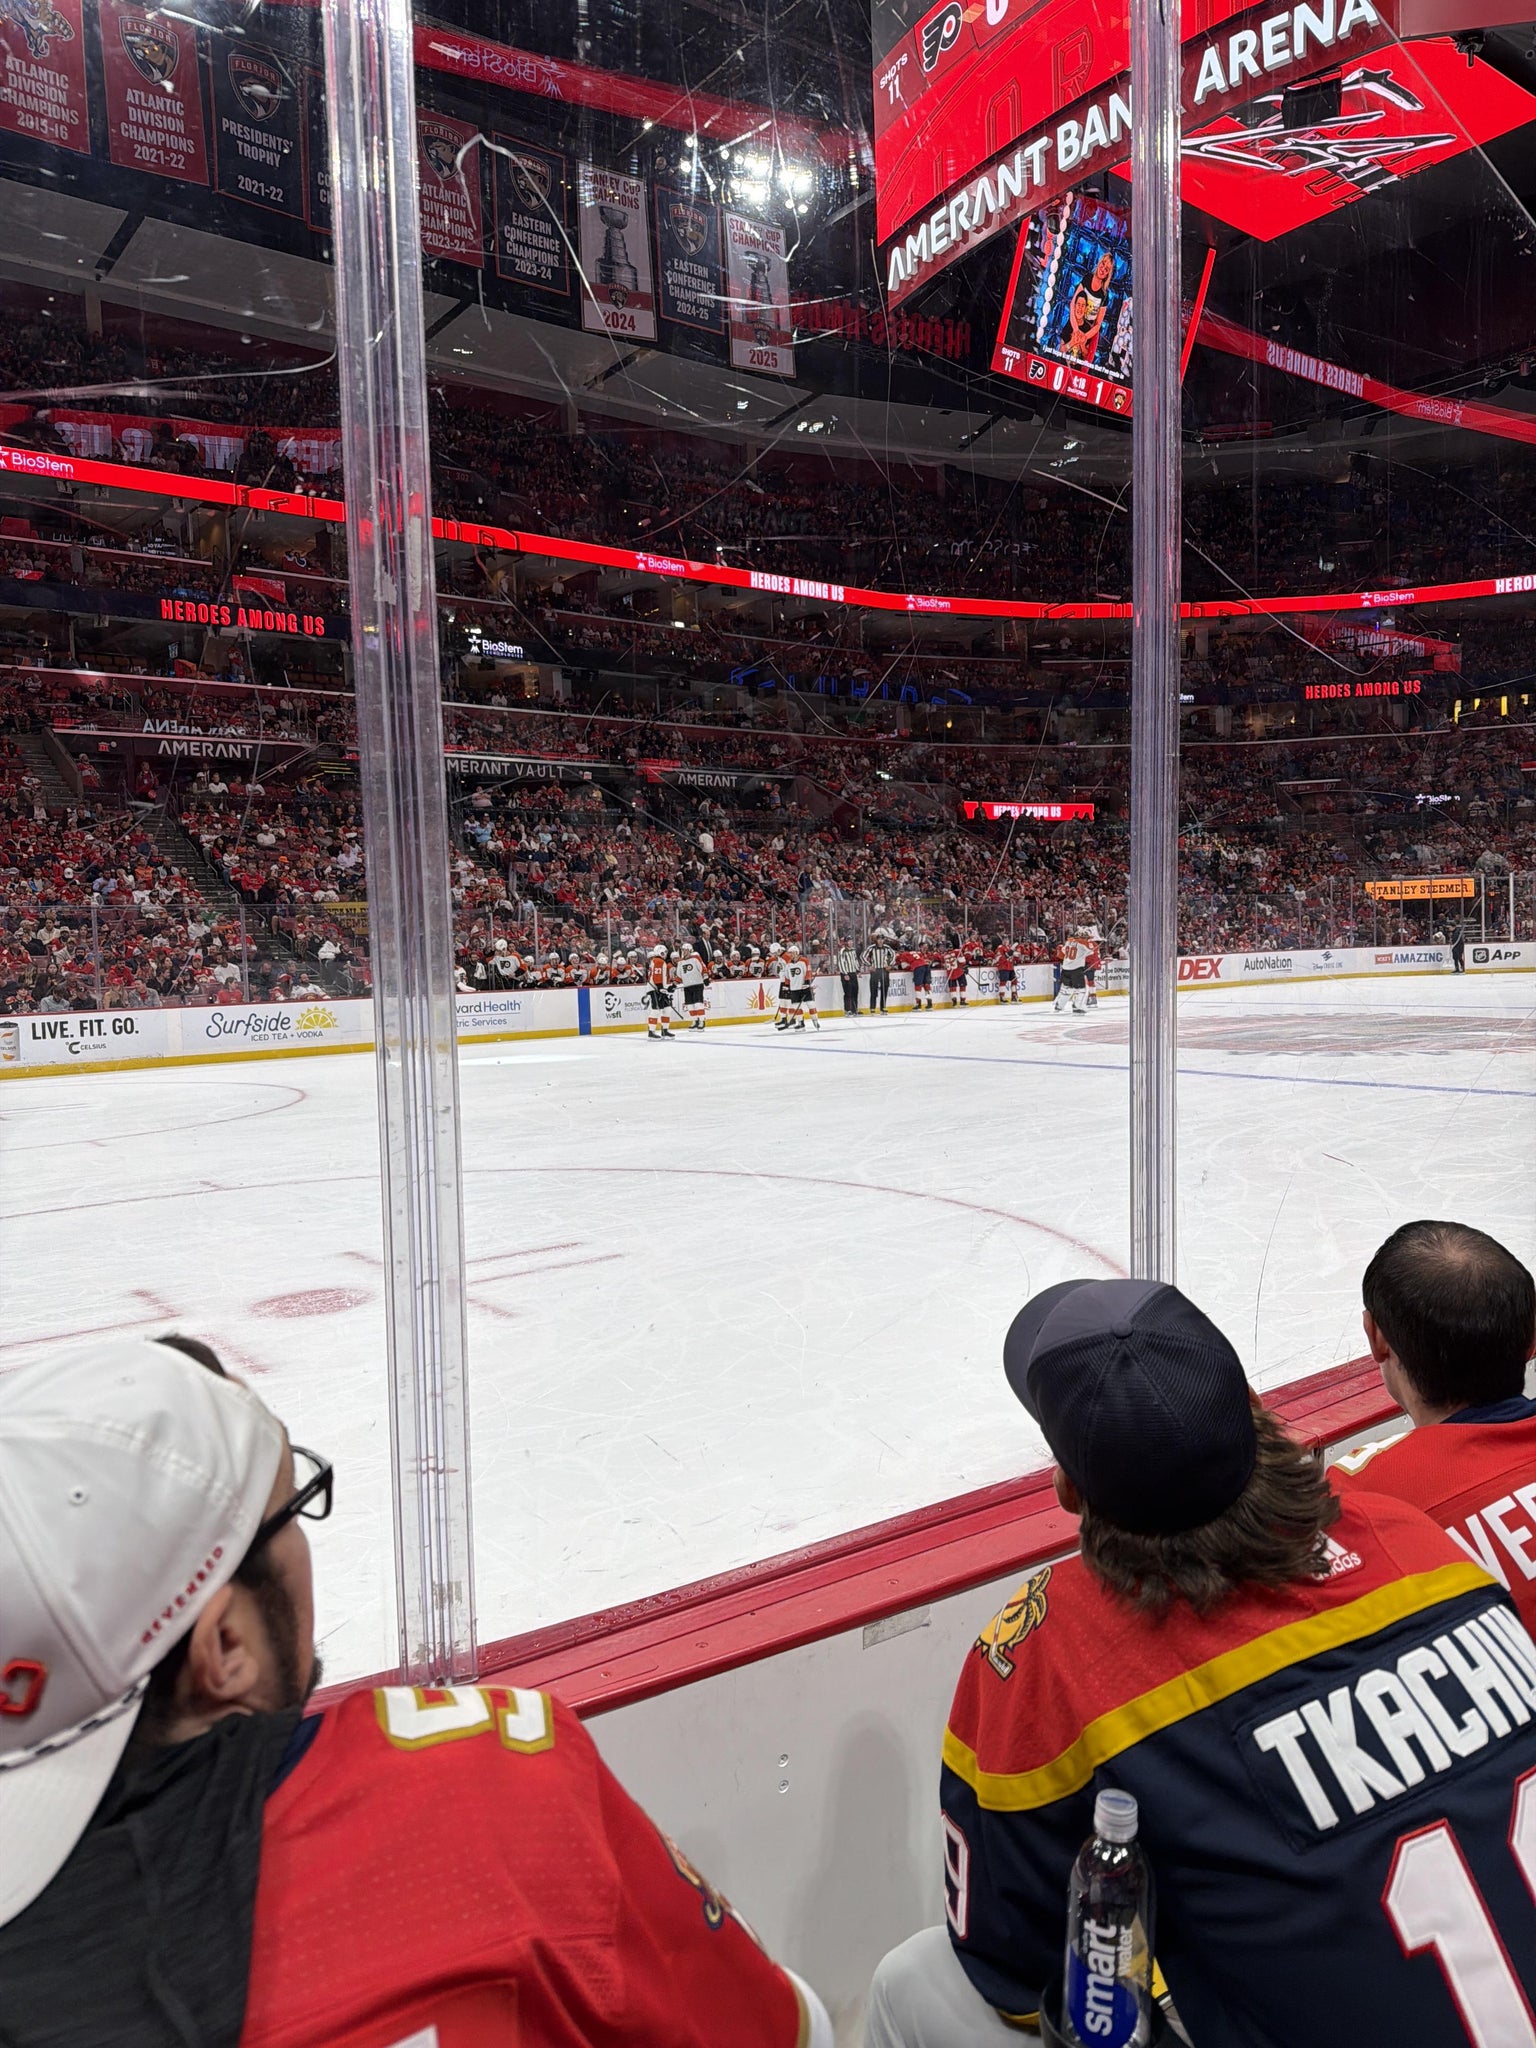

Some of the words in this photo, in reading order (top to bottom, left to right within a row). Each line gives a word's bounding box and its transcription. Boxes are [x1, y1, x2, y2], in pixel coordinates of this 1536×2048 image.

[6, 55, 69, 89] ATLANTIC
[880, 52, 908, 90] SHOTS
[8, 72, 67, 105] DIVISION
[888, 74, 902, 105] 11
[0, 86, 79, 125] CHAMPIONS
[126, 88, 184, 116] ATLANTIC
[17, 111, 68, 140] 2015-16
[129, 106, 184, 134] DIVISION
[121, 122, 195, 154] CHAMPIONS
[888, 136, 1050, 291] AMERANT
[1194, 0, 1380, 104] ARENA
[134, 144, 185, 169] 2021-22
[236, 140, 281, 168] TROPHY
[238, 175, 284, 203] 2021-22
[422, 183, 467, 208] ATLANTIC
[423, 199, 466, 223] DIVISION
[512, 212, 552, 236] EASTERN
[765, 229, 781, 242] CUP
[504, 225, 561, 253] CONFERENCE
[506, 241, 560, 268] CHAMPIONS
[515, 258, 552, 281] 2023-24
[673, 259, 709, 279] EASTERN
[667, 270, 716, 295] CONFERENCE
[603, 310, 636, 332] 2024
[676, 301, 709, 321] 2024-25
[750, 350, 778, 369] 2025
[12, 452, 74, 474] BioStem
[648, 557, 685, 573] BioStem
[751, 571, 790, 593] HEROES
[793, 581, 828, 599] AMONG
[831, 586, 844, 601] US
[1374, 591, 1415, 603] BioStem
[161, 599, 231, 626] HEROES
[237, 607, 298, 634] AMONG
[303, 615, 325, 636] US
[482, 639, 523, 655] BioStem
[1305, 684, 1351, 700] HEROES
[1355, 681, 1399, 698] AMONG
[1403, 680, 1422, 695] US
[158, 740, 253, 759] AMERANT
[445, 759, 511, 776] MERANT
[516, 764, 565, 780] VAULT
[677, 773, 738, 788] AMERANT
[1050, 806, 1061, 818] US
[1370, 885, 1417, 897] STANLEY
[1178, 958, 1224, 981] DEX
[1243, 956, 1292, 971] AutoNation
[1394, 952, 1443, 964] AMAZING
[484, 1000, 521, 1012] Health
[32, 1020, 74, 1040] LIVE.
[80, 1018, 107, 1037] FIT.
[112, 1017, 139, 1035] GO.
[206, 1011, 291, 1039] Surfside
[472, 1017, 507, 1027] Services
[251, 1034, 269, 1042] ICED
[273, 1033, 288, 1041] TEA
[297, 1031, 324, 1039] VODKA
[1117, 1925, 1133, 1978] water
[1084, 1918, 1118, 2037] smart
